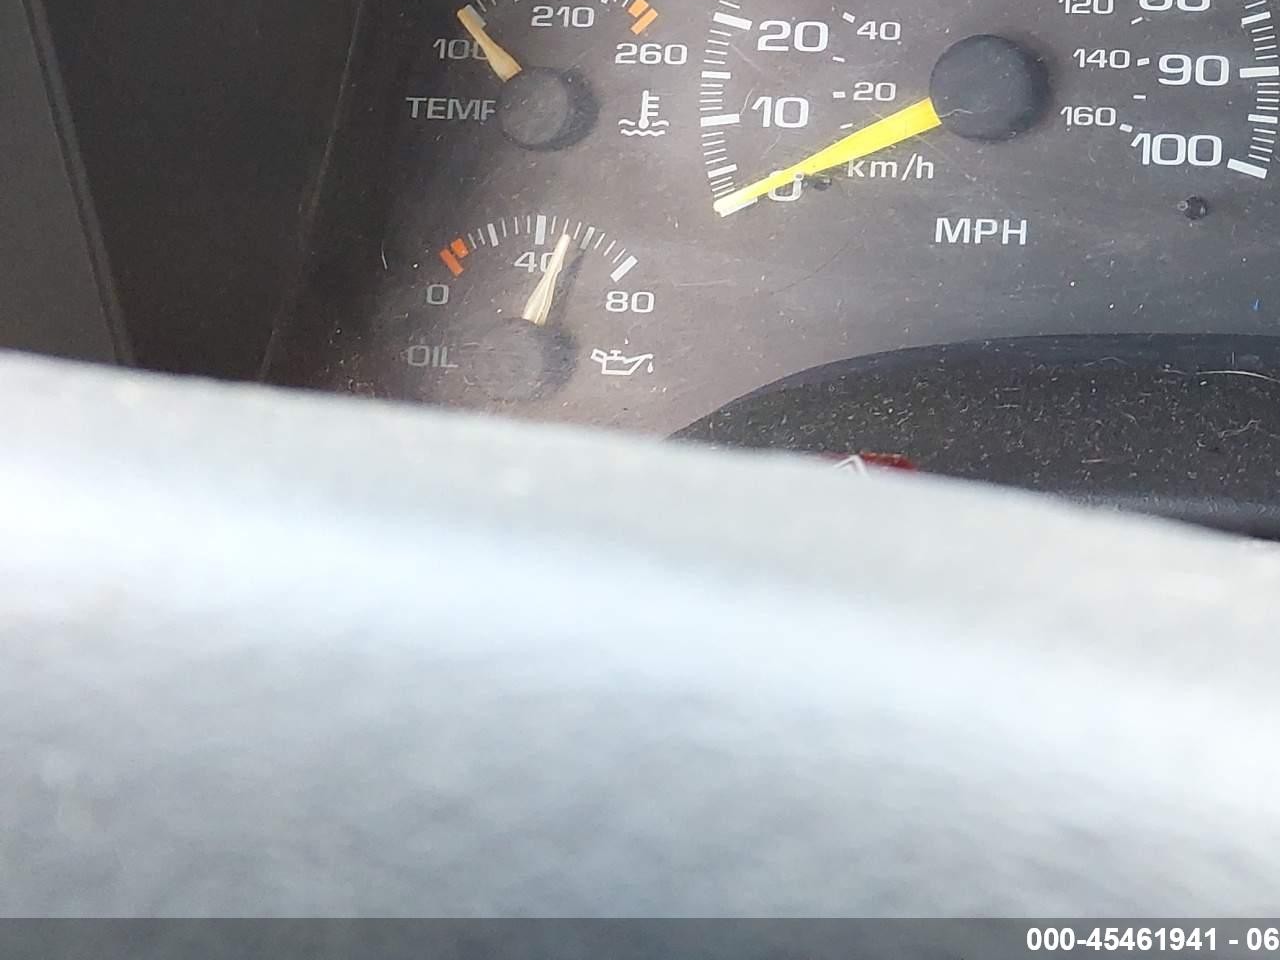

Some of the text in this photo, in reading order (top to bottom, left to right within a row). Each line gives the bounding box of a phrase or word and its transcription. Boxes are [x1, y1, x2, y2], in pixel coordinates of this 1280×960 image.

[531, 6, 594, 28] 210
[757, 20, 829, 52] 20
[856, 21, 901, 40] 40
[615, 43, 688, 65] 260
[1072, 49, 1130, 69] 140
[1158, 54, 1230, 86] 90
[853, 82, 896, 101] 20
[752, 96, 809, 128] 10
[1060, 106, 1117, 126] 160
[1130, 133, 1223, 166] 100
[848, 153, 934, 181] km/h
[767, 170, 803, 201] 0
[935, 217, 1027, 245] MPH
[426, 284, 448, 305] 0
[605, 291, 655, 313] 80
[407, 345, 458, 368] OIL
